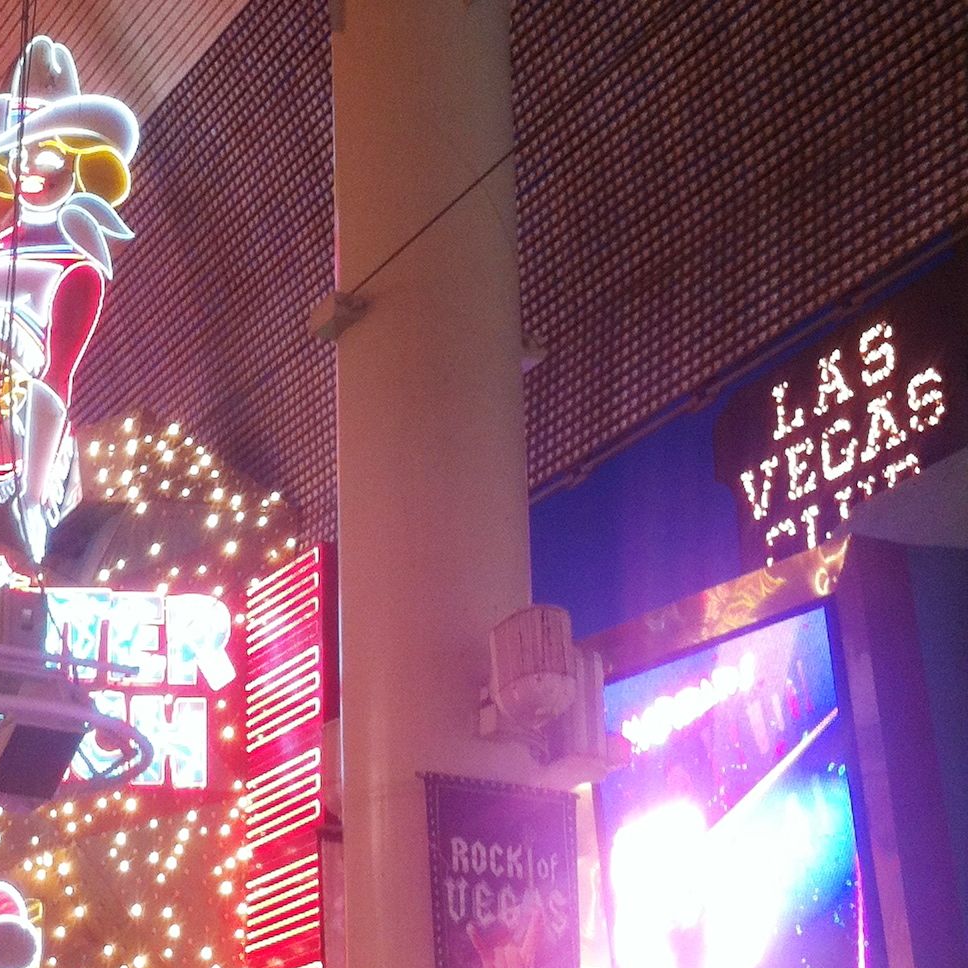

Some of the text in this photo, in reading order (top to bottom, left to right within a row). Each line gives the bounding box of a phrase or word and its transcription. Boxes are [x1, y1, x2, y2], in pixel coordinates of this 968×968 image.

[771, 320, 895, 440] LAS
[740, 367, 946, 521] VEGAS
[450, 836, 524, 879] ROCK
